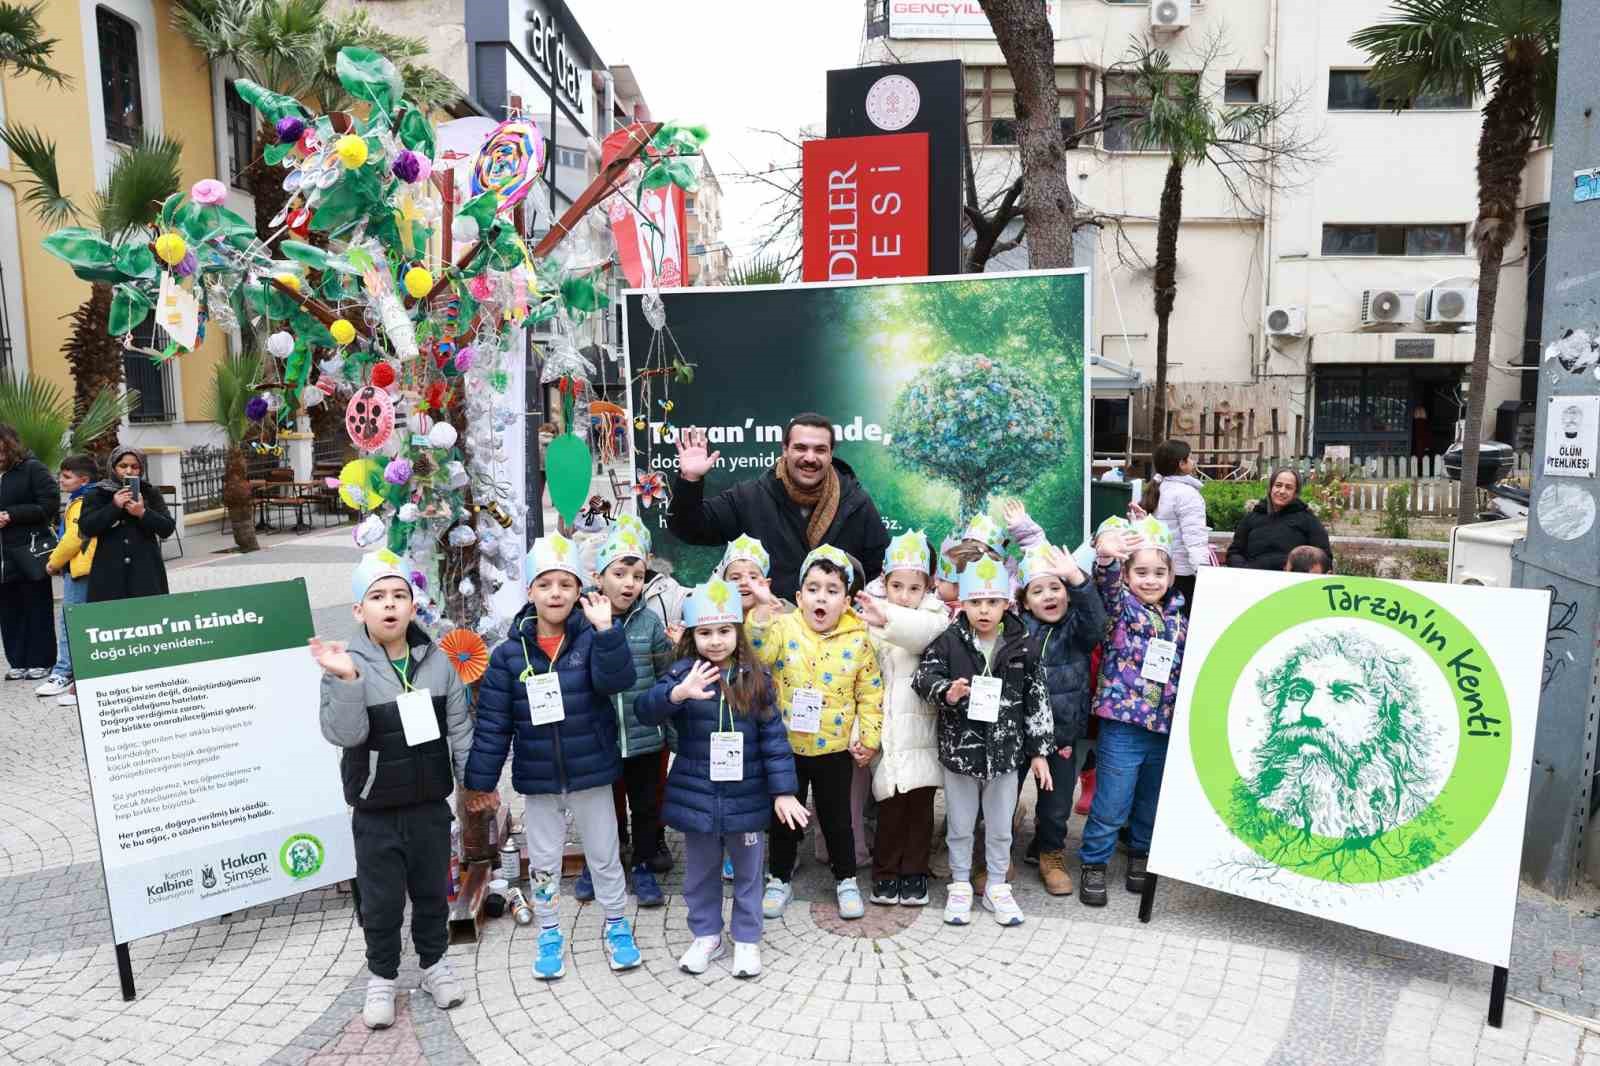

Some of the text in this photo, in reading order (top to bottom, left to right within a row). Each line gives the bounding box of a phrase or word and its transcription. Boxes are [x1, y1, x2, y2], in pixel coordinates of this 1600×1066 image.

[1559, 444, 1582, 457] ÖLÜM
[86, 609, 263, 643] Tarzan'ın izinde,
[90, 637, 213, 661] doğa için yeniden...
[1322, 584, 1502, 738] Tarzan'ın Kenti
[220, 852, 267, 870] Hakan
[223, 862, 269, 886] Şimşek
[146, 878, 193, 896] Kalbine
